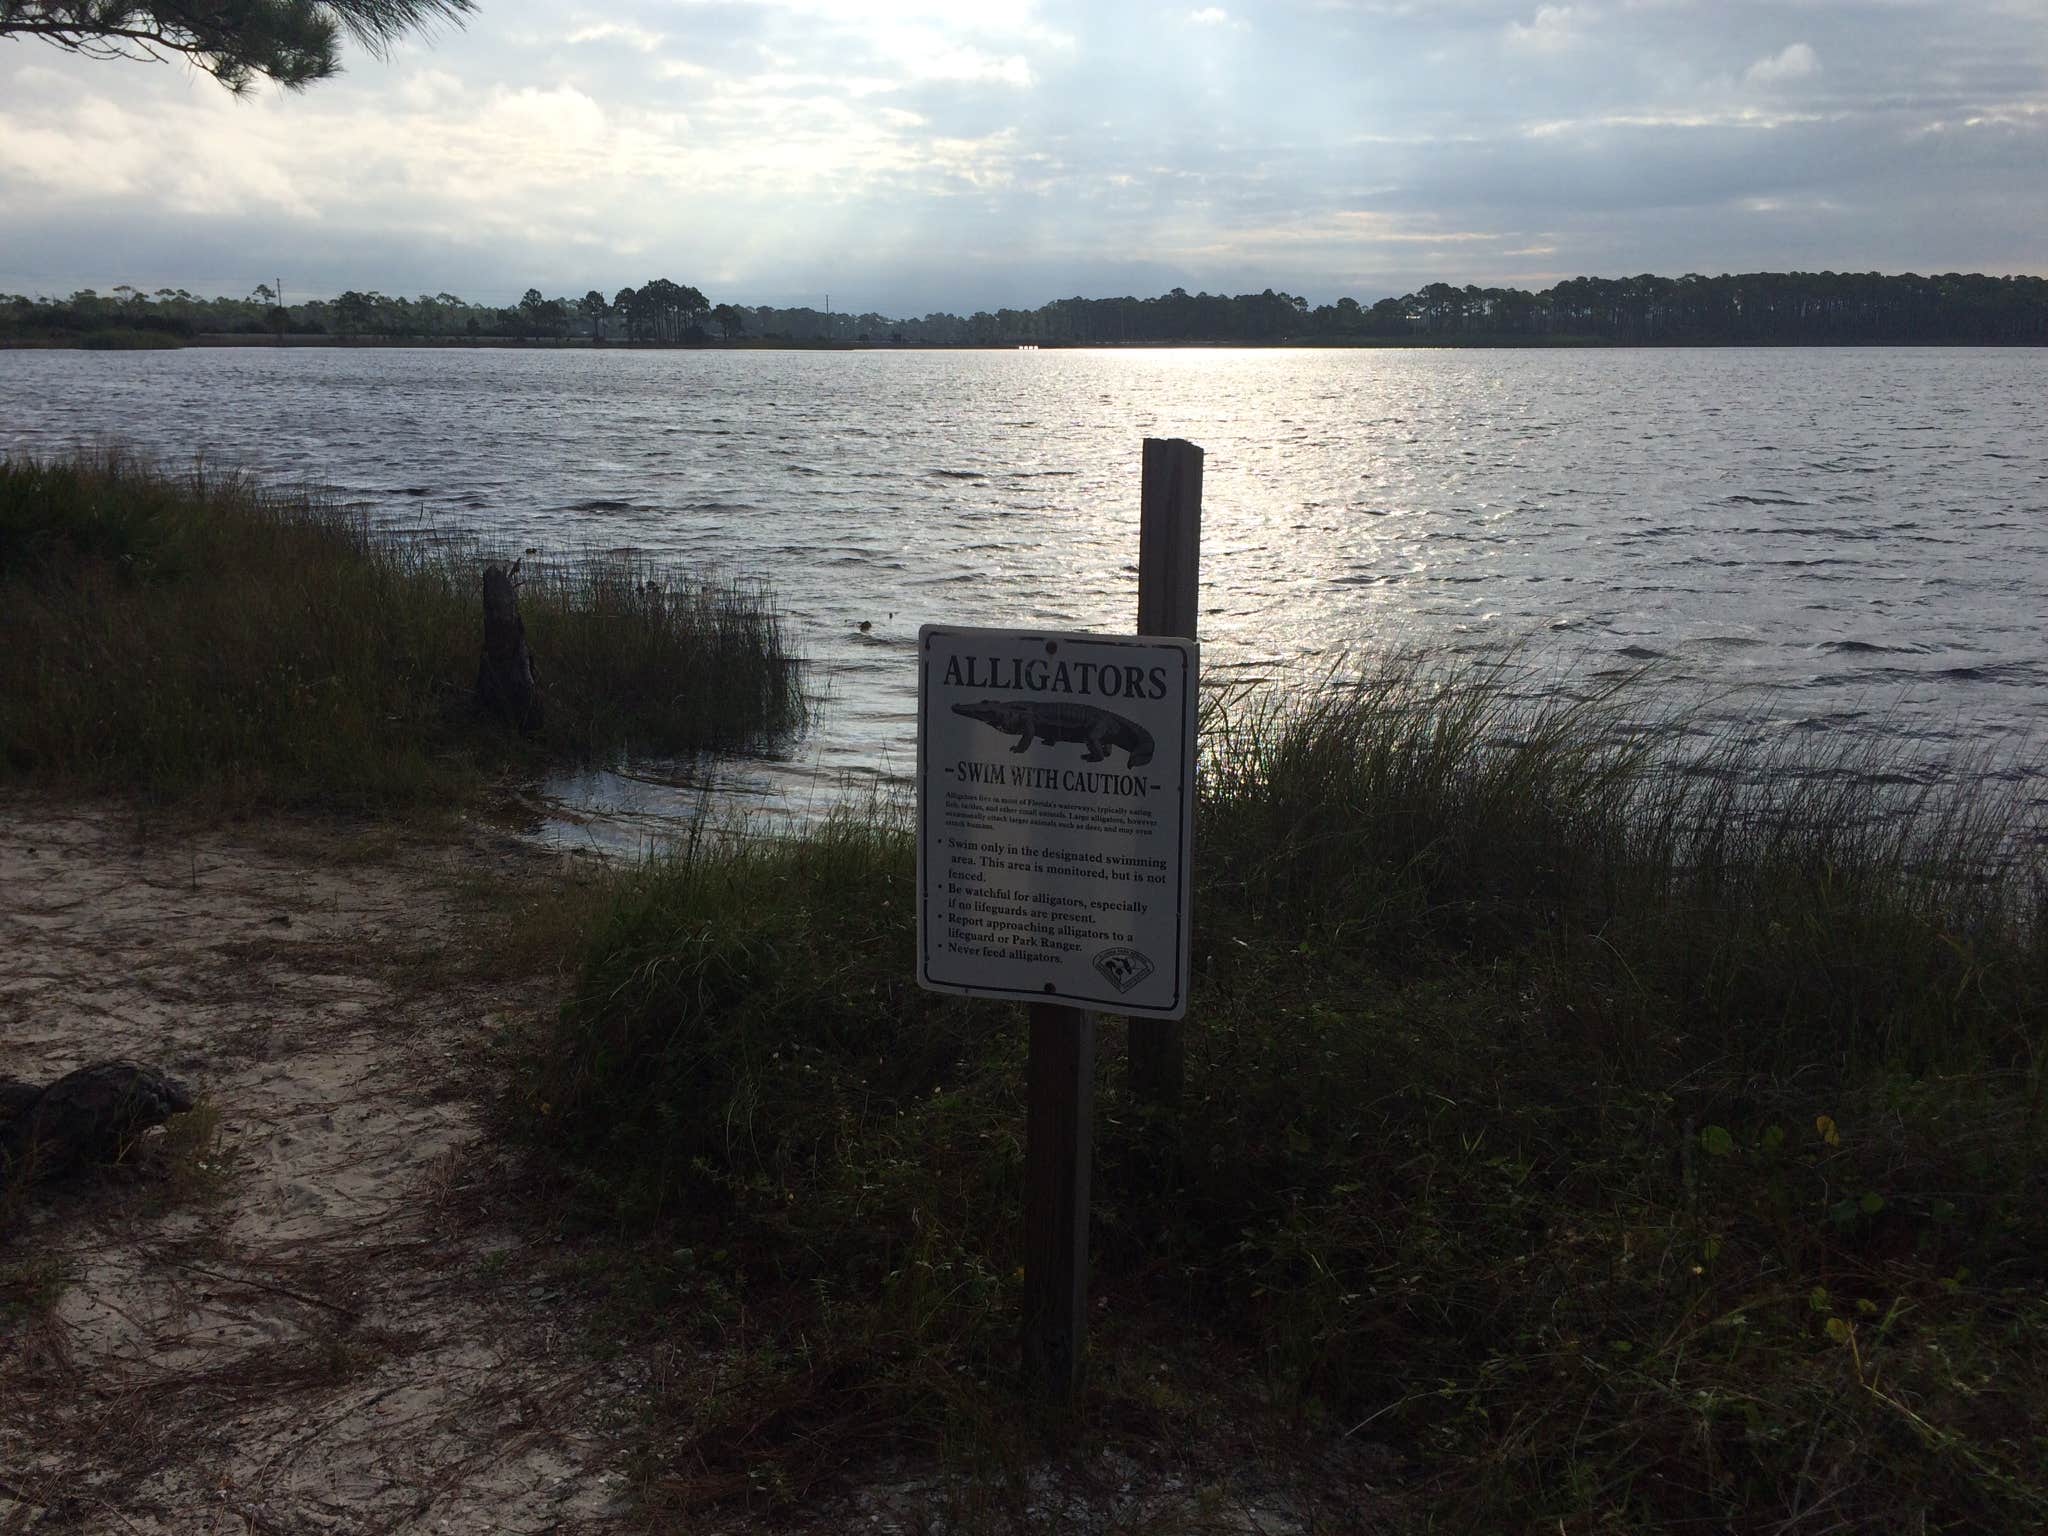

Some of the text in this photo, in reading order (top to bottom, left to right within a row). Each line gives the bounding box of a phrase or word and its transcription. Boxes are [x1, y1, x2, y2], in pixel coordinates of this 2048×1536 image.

[943, 655, 1167, 700] ALLIGATORS
[1011, 767, 1057, 790] WITH
[948, 839, 1167, 870] Swim only in the designated swimming
[948, 869, 986, 882] fenced.
[951, 855, 1166, 884] area. This area is monitored, but is not
[948, 883, 1148, 915] Be watchful for alligators, especially
[958, 901, 972, 910] no
[974, 900, 1028, 916] lifeguards
[1030, 910, 1048, 919] are
[1051, 911, 1096, 924] present.
[948, 912, 1134, 942] Report approaching alligators to a
[948, 927, 1083, 952] lifeguard or Park Ranger.
[948, 942, 1064, 964] Never feed alligators.
